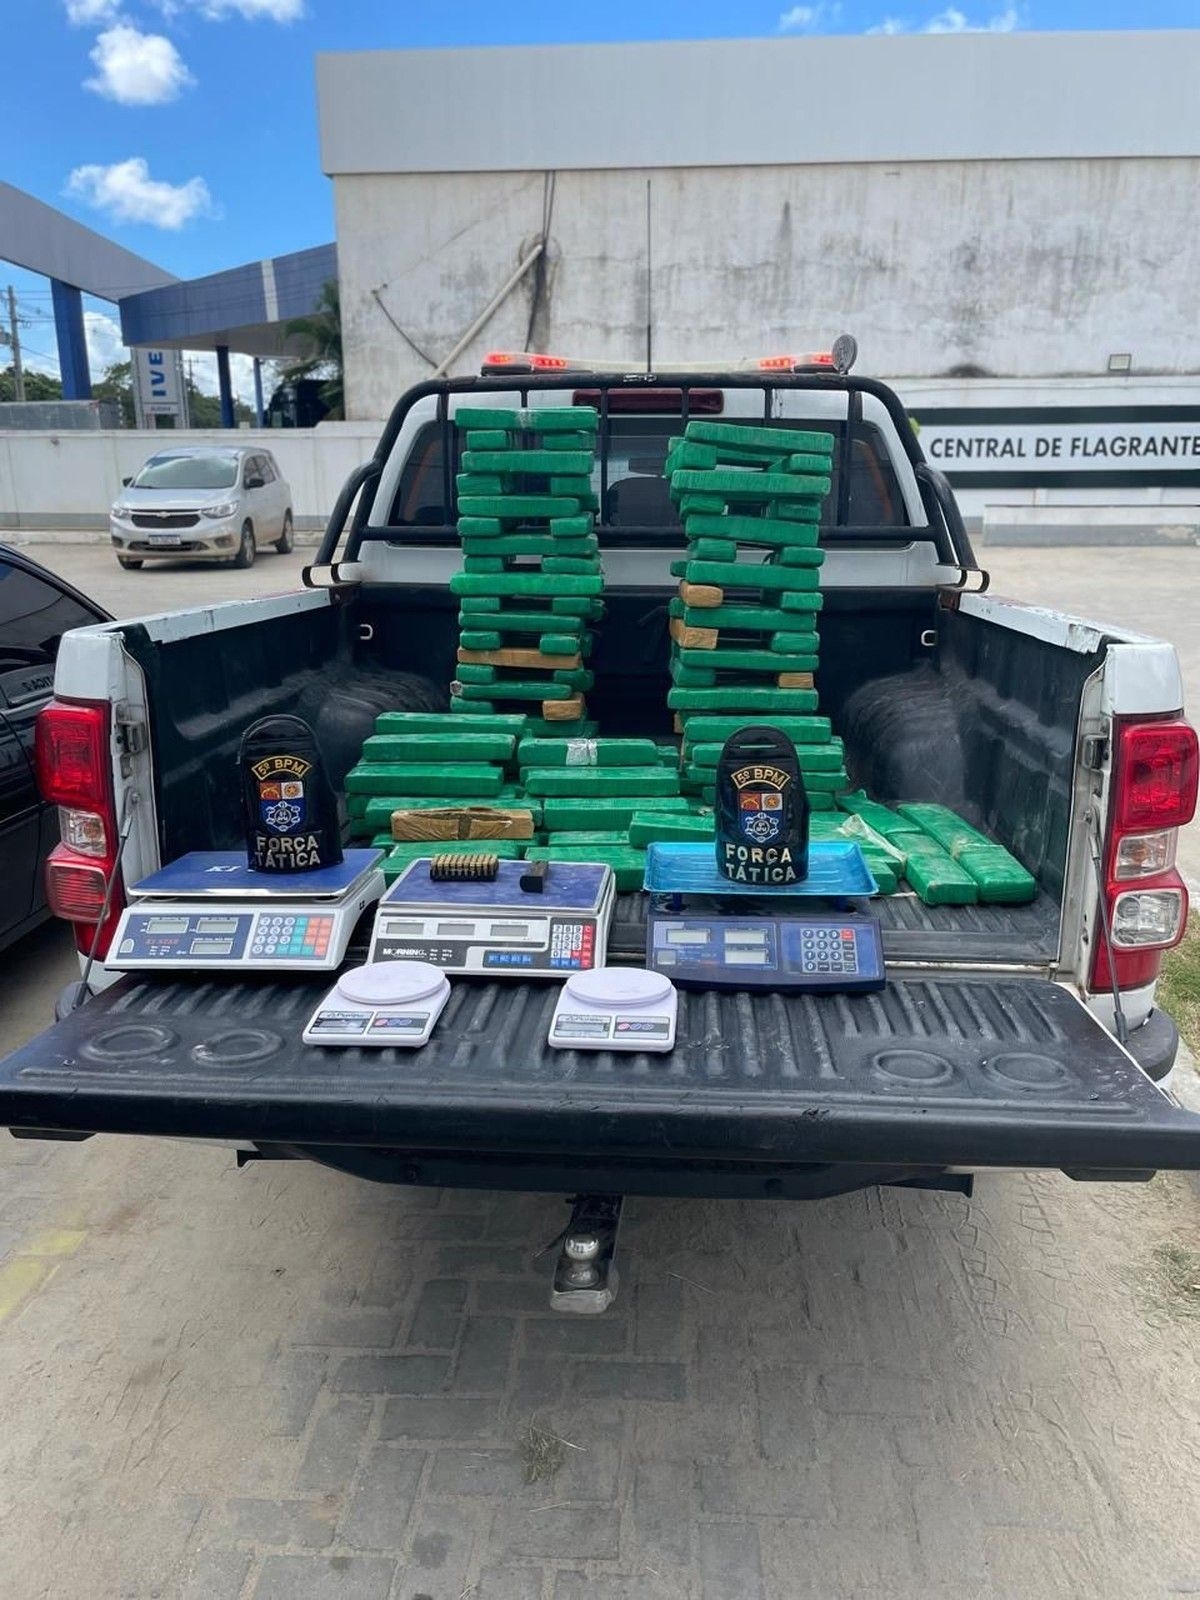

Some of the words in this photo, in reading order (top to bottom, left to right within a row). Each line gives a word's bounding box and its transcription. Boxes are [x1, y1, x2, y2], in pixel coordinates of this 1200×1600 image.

[930, 438, 1026, 458] CENTRAL
[1034, 437, 1063, 457] DE
[1070, 435, 1200, 457] FLAGRANTE
[274, 759, 305, 773] BPM
[754, 768, 785, 785] BPM
[256, 835, 319, 853] FORÇA
[725, 843, 793, 865] FORÇA
[255, 849, 321, 869] TÁTICA
[725, 861, 797, 882] TÁTICA
